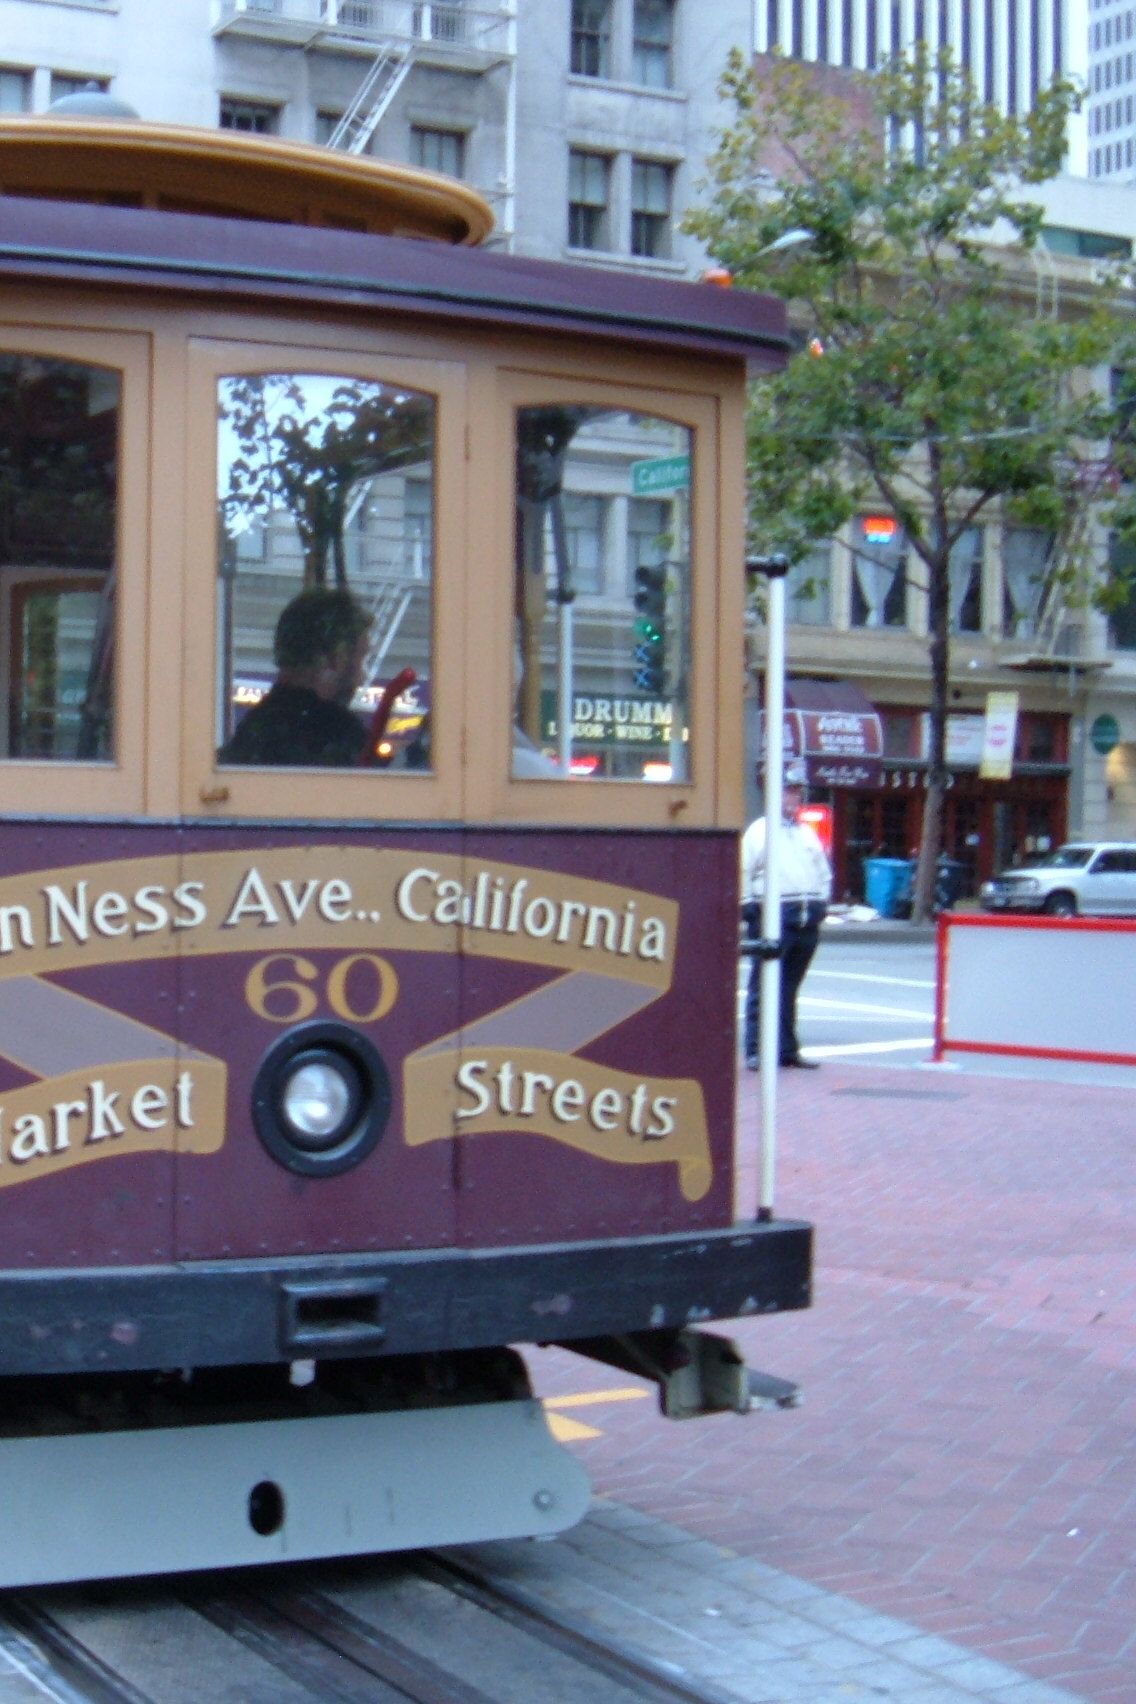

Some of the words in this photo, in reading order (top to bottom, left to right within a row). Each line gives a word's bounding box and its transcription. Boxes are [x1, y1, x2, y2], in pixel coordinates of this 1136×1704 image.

[42, 880, 207, 945] Ness
[397, 867, 667, 962] California
[245, 952, 399, 1024] 60
[454, 1060, 678, 1141] Streets
